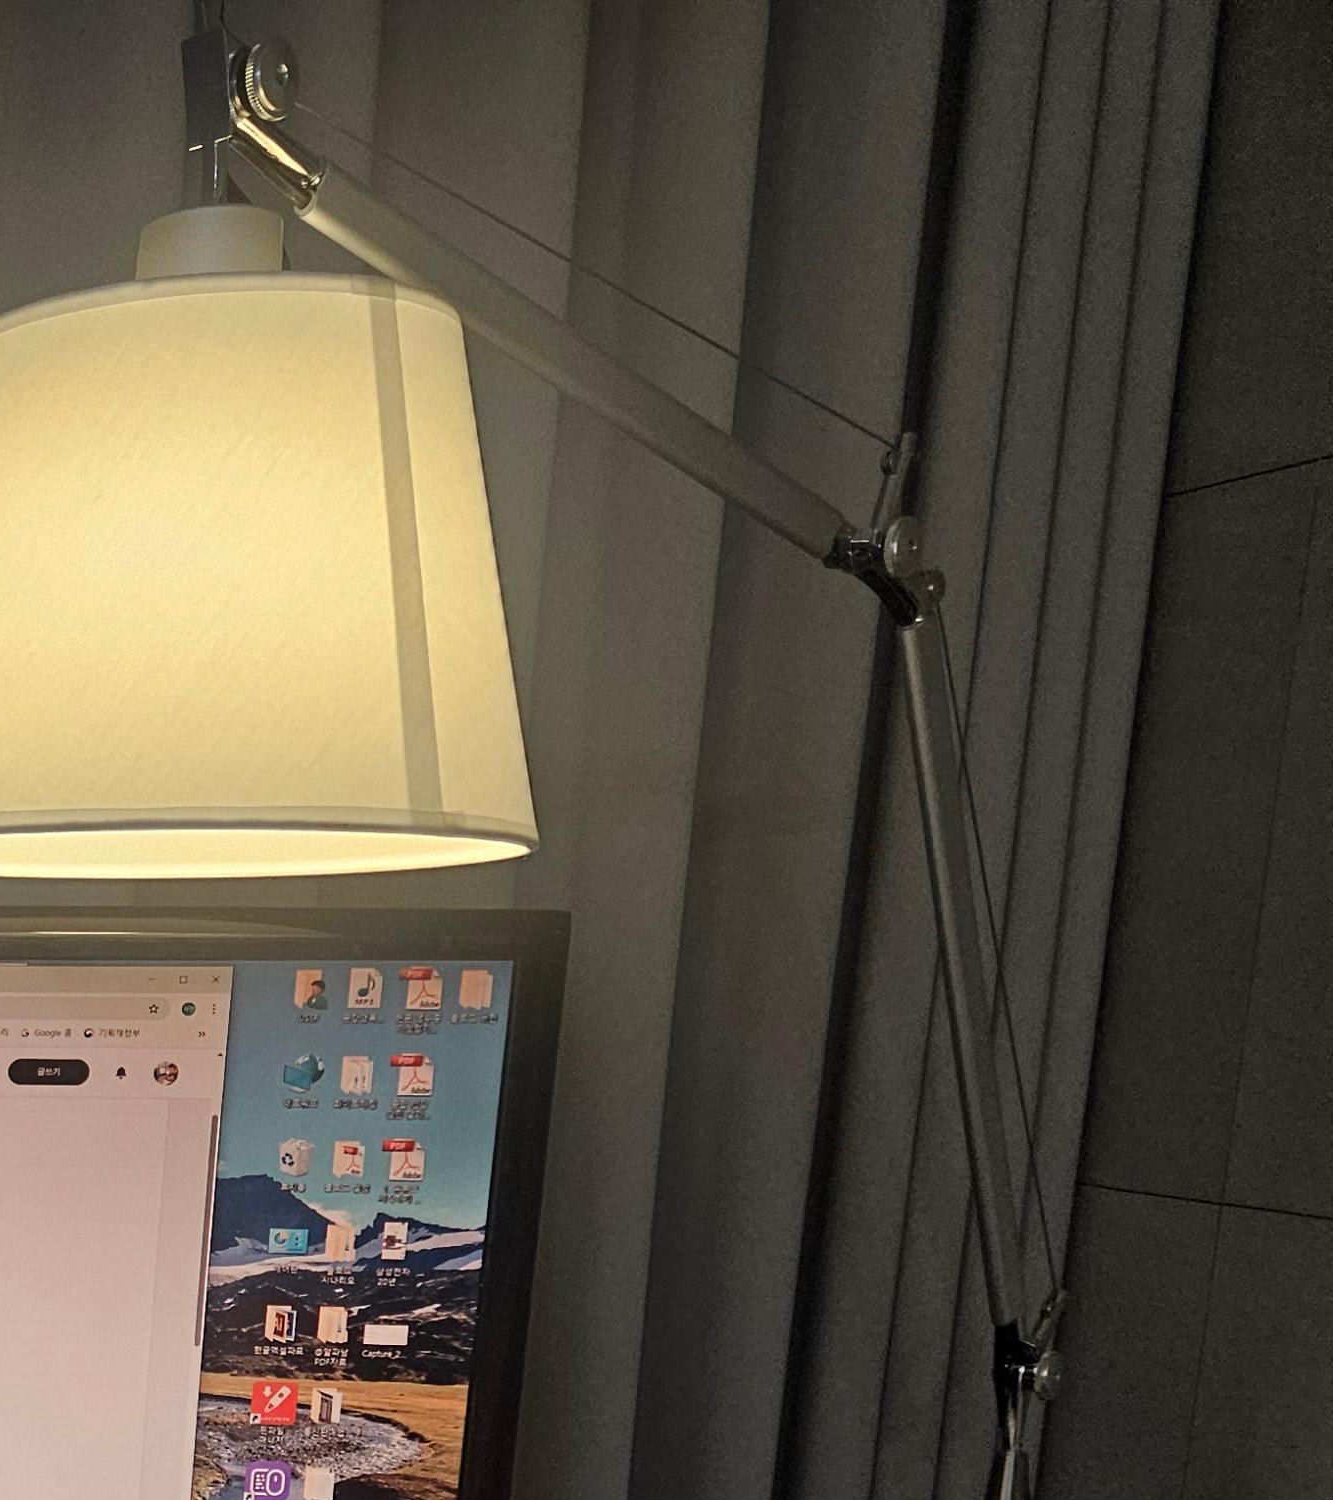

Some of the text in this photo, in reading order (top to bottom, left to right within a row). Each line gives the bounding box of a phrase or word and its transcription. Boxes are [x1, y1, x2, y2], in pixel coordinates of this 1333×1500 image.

[34, 1029, 61, 1038] Google
[399, 1056, 414, 1065] PDF
[37, 1067, 61, 1077] 글쓰기
